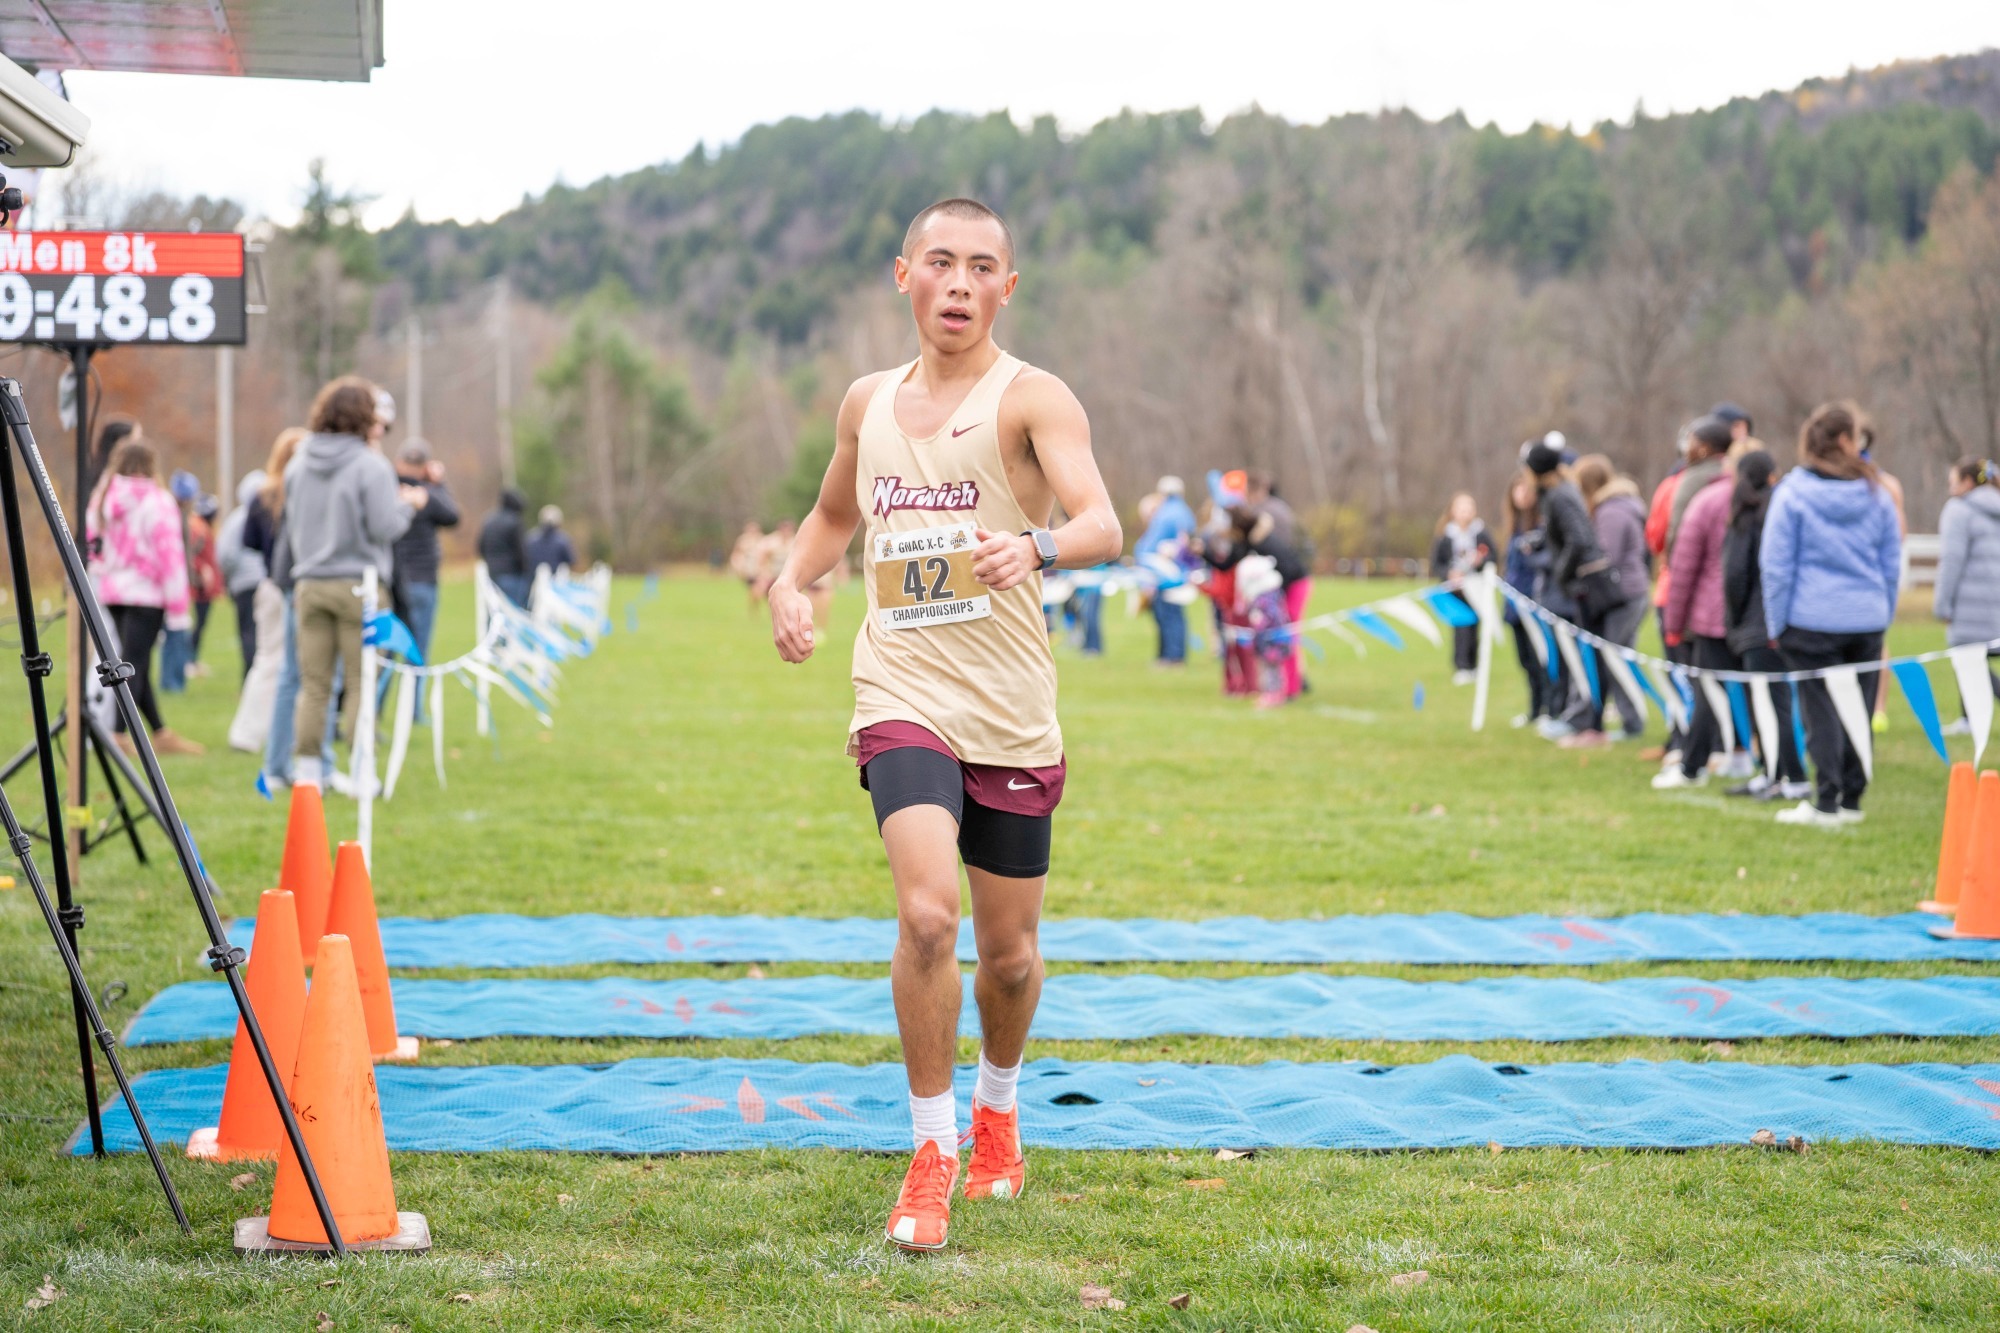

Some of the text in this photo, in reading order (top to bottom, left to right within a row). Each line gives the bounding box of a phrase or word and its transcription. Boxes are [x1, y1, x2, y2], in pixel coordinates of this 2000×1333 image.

[0, 232, 157, 273] Men 8k
[873, 476, 980, 521] Norwich
[898, 539, 925, 554] GNAC
[926, 536, 944, 550] X-C
[902, 554, 954, 603] 42
[892, 600, 974, 622] CHAMPIONSHIPS
